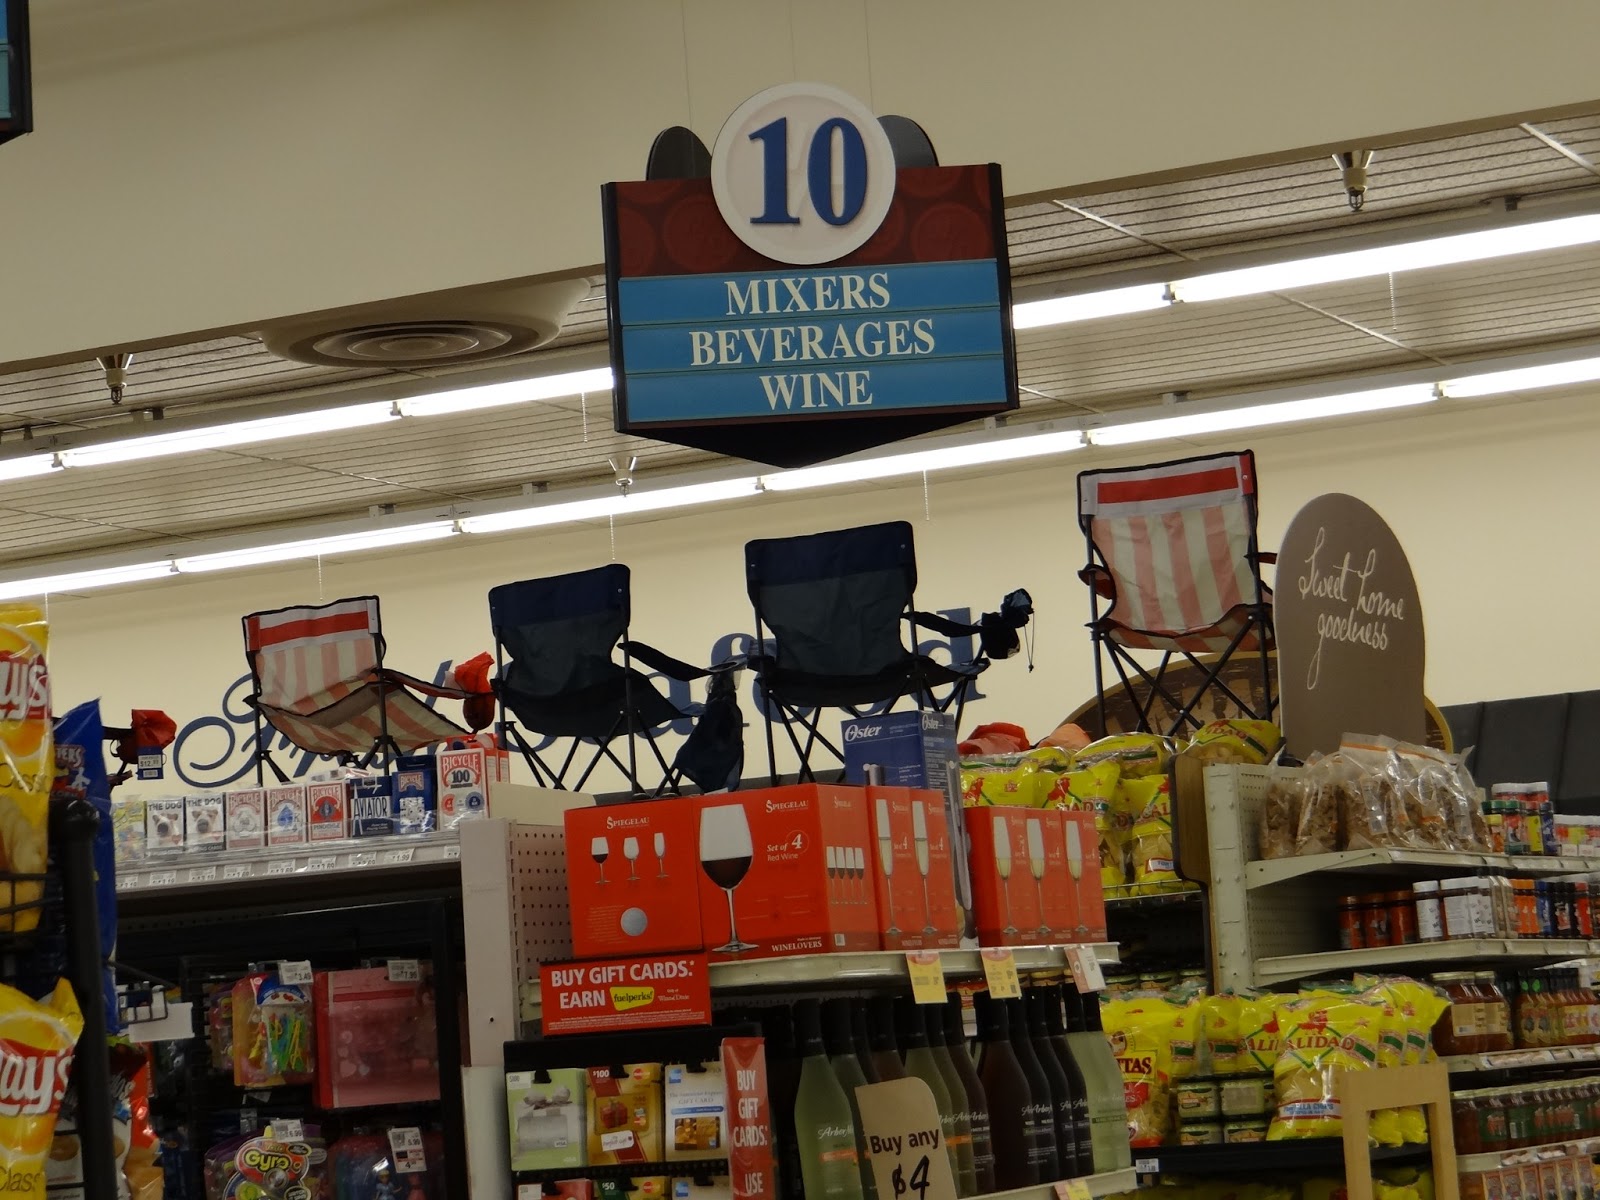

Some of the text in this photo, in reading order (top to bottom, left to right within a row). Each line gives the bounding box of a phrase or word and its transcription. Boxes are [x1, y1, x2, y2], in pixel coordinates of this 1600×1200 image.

[748, 116, 867, 226] 10
[724, 272, 891, 316] MIXERS
[688, 318, 936, 367] BEVERAGES
[758, 370, 874, 411] WINE
[1306, 608, 1388, 690] goodness
[845, 724, 882, 742] Oster
[442, 753, 479, 776] BICYCLE
[451, 769, 471, 783] 100
[186, 798, 222, 808] THE DOG
[312, 785, 340, 803] BICYCLE
[148, 802, 182, 811] THE DOG
[353, 796, 388, 818] AVIATOR
[765, 799, 809, 813] SPIEGELAU
[606, 815, 650, 829] SPIEGELAU
[767, 833, 802, 852] Set of 4
[767, 853, 799, 862] Red Wine
[771, 940, 823, 953] WINELOVERS
[551, 968, 586, 987] BUY
[589, 965, 626, 984] GIFT
[559, 989, 606, 1010] EARN
[593, 1069, 610, 1078] $100
[736, 1070, 756, 1091] BUY
[738, 1097, 759, 1119] GIFT
[869, 1128, 939, 1156] Buy any
[244, 1151, 291, 1172] Gyro
[602, 1182, 615, 1191] $50
[745, 1172, 764, 1194] USE
[891, 1155, 930, 1200] $4
